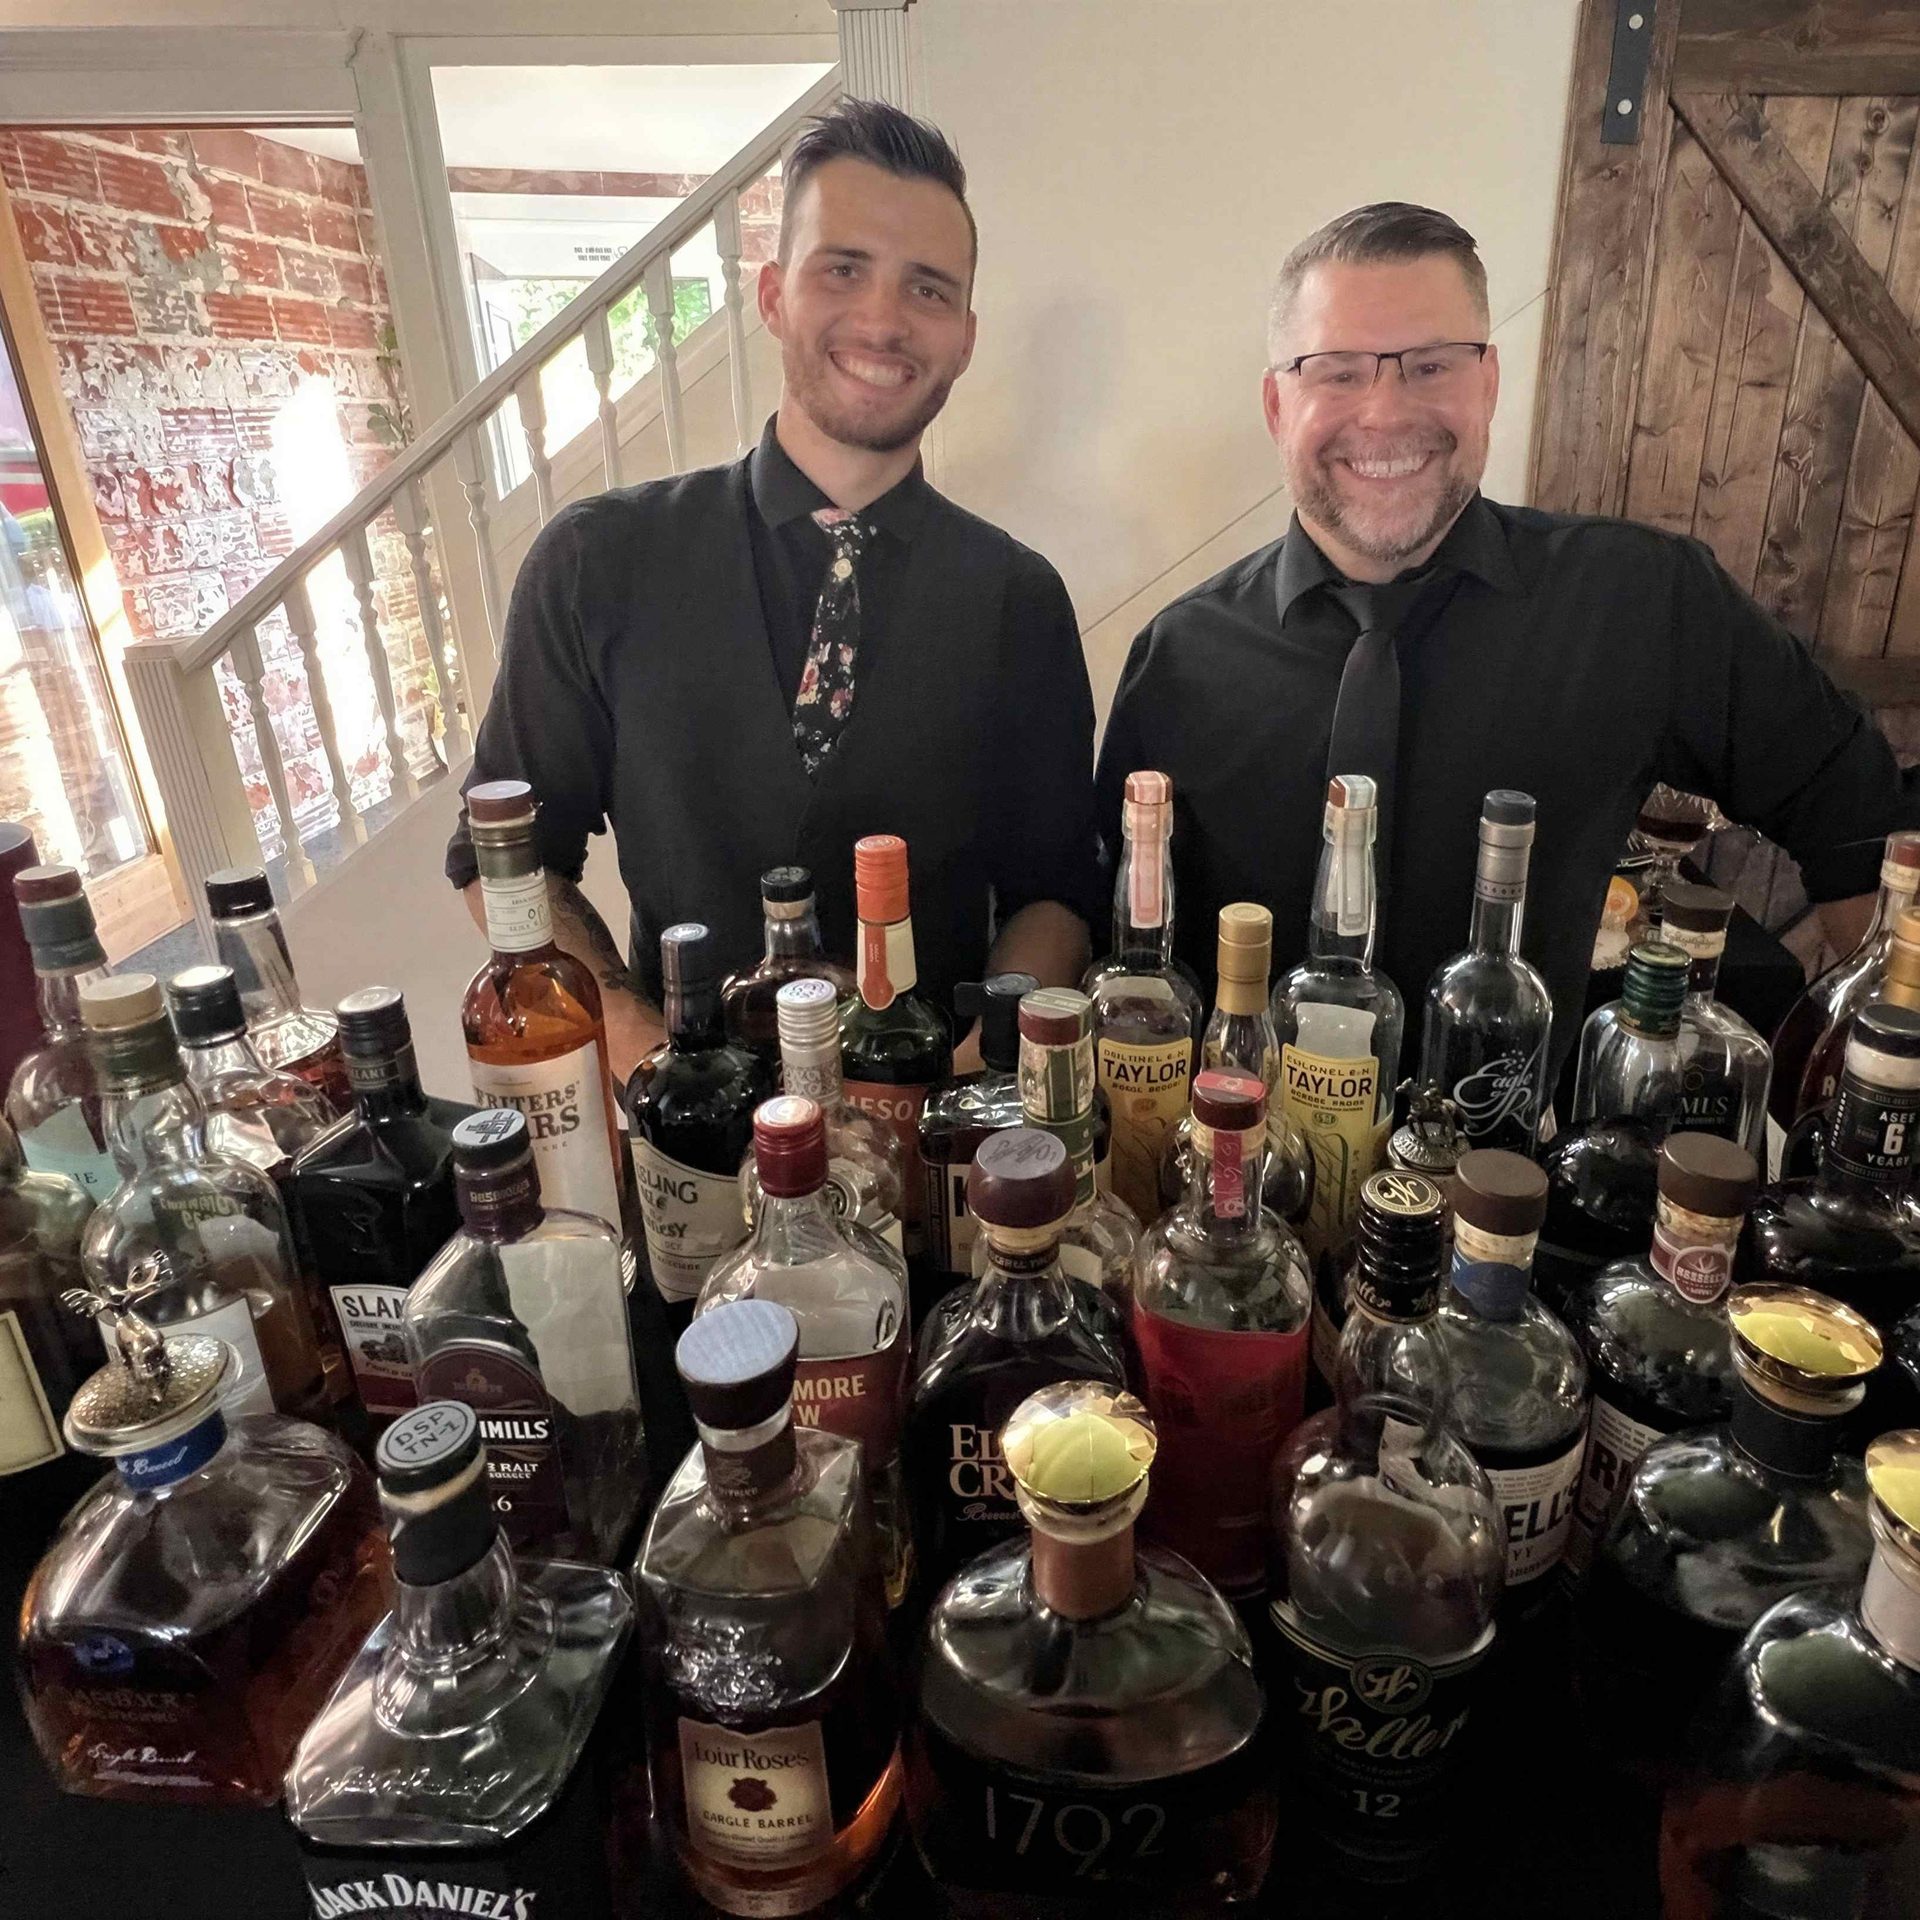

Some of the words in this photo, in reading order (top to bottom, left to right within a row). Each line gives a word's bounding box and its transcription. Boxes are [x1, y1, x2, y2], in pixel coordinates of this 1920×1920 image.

[1104, 1059, 1187, 1084] TAYLOR
[1286, 1064, 1372, 1099] TAYLOR
[1883, 1123, 1905, 1155] 6
[793, 1374, 866, 1402] MORE
[395, 1411, 445, 1446] DSP
[743, 1748, 810, 1771] Roses
[1352, 1788, 1401, 1818] 12
[757, 1813, 813, 1829] BARREL
[985, 1785, 1167, 1876] 1792
[308, 1880, 390, 1920] JACK
[382, 1873, 537, 1920] DANIEL'S
